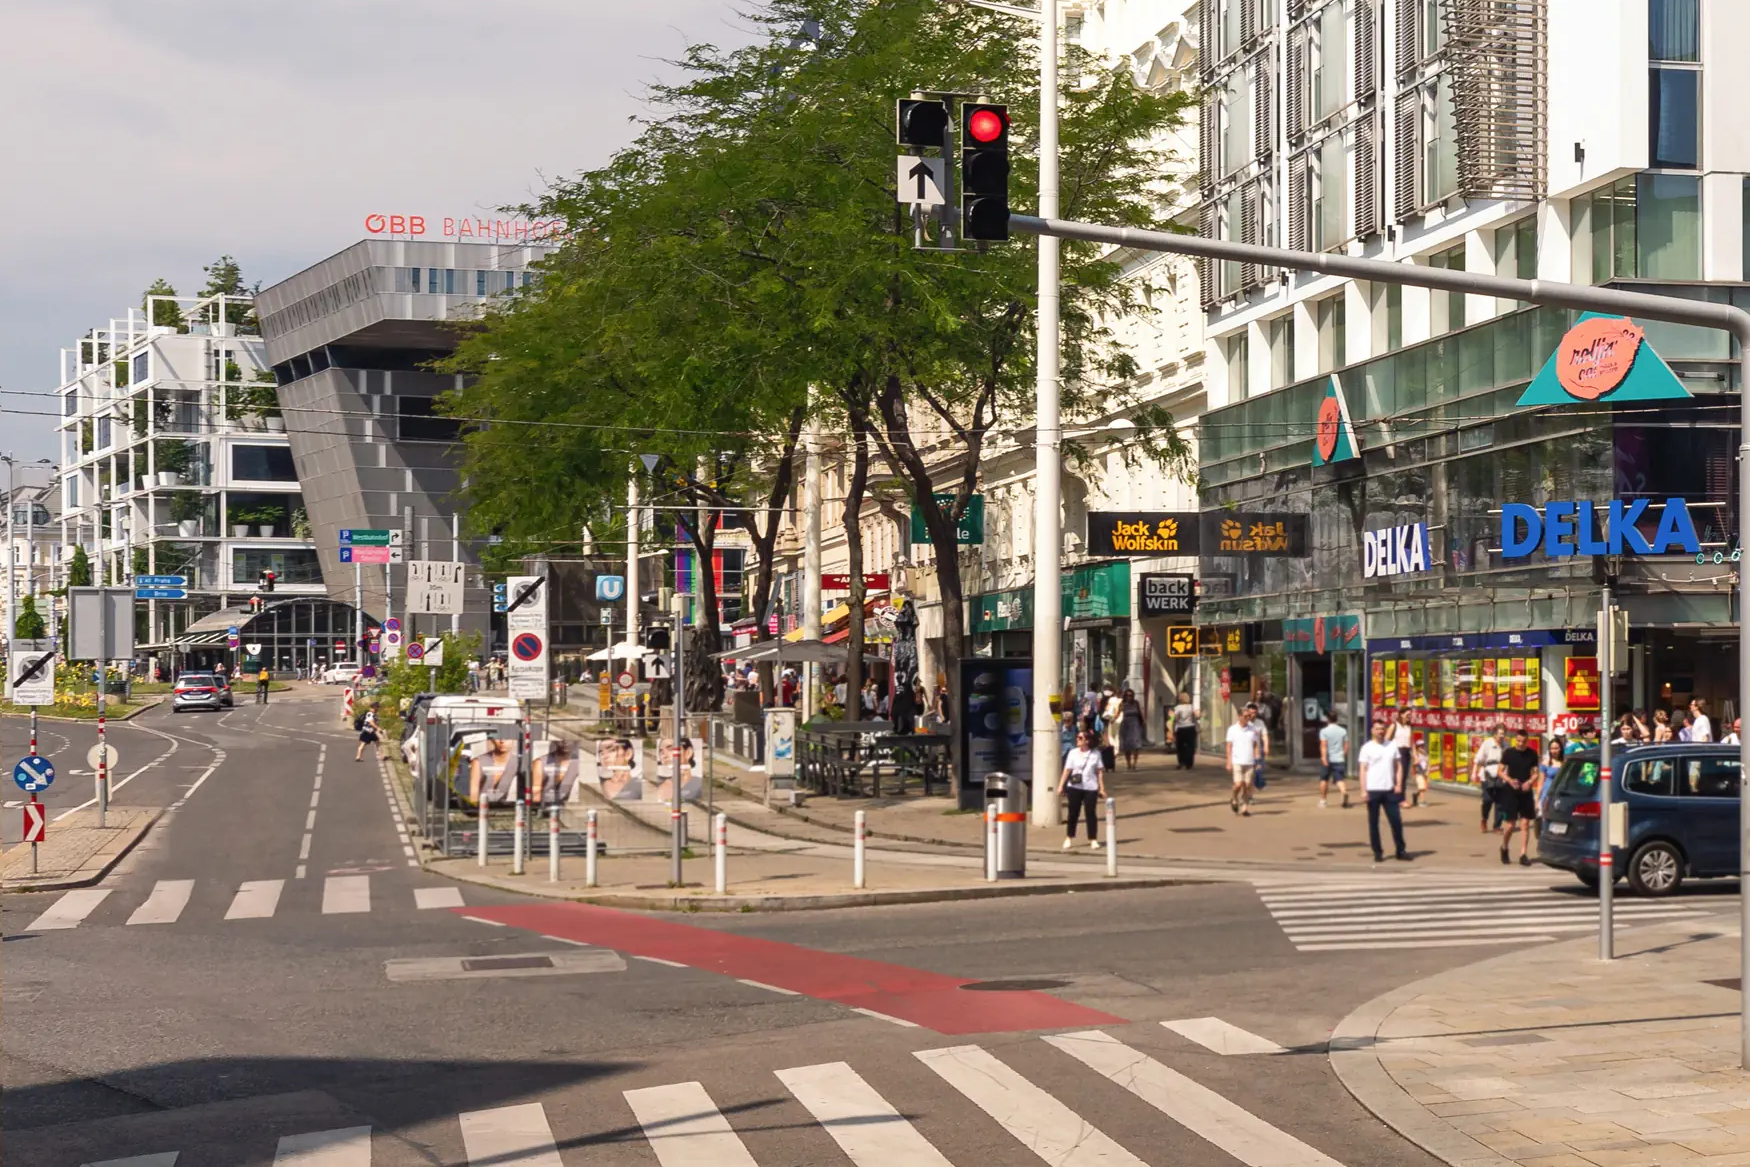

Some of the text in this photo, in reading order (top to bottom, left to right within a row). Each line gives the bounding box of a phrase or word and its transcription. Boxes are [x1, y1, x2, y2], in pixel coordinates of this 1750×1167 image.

[1112, 520, 1150, 536] Jack
[1501, 498, 1700, 557] DELKA
[1112, 536, 1178, 551] Wolfskin
[1364, 522, 1426, 579] DELKA
[603, 581, 618, 598] U
[1149, 578, 1187, 594] back
[1146, 597, 1189, 609] WERK
[1565, 632, 1593, 642] DELKA
